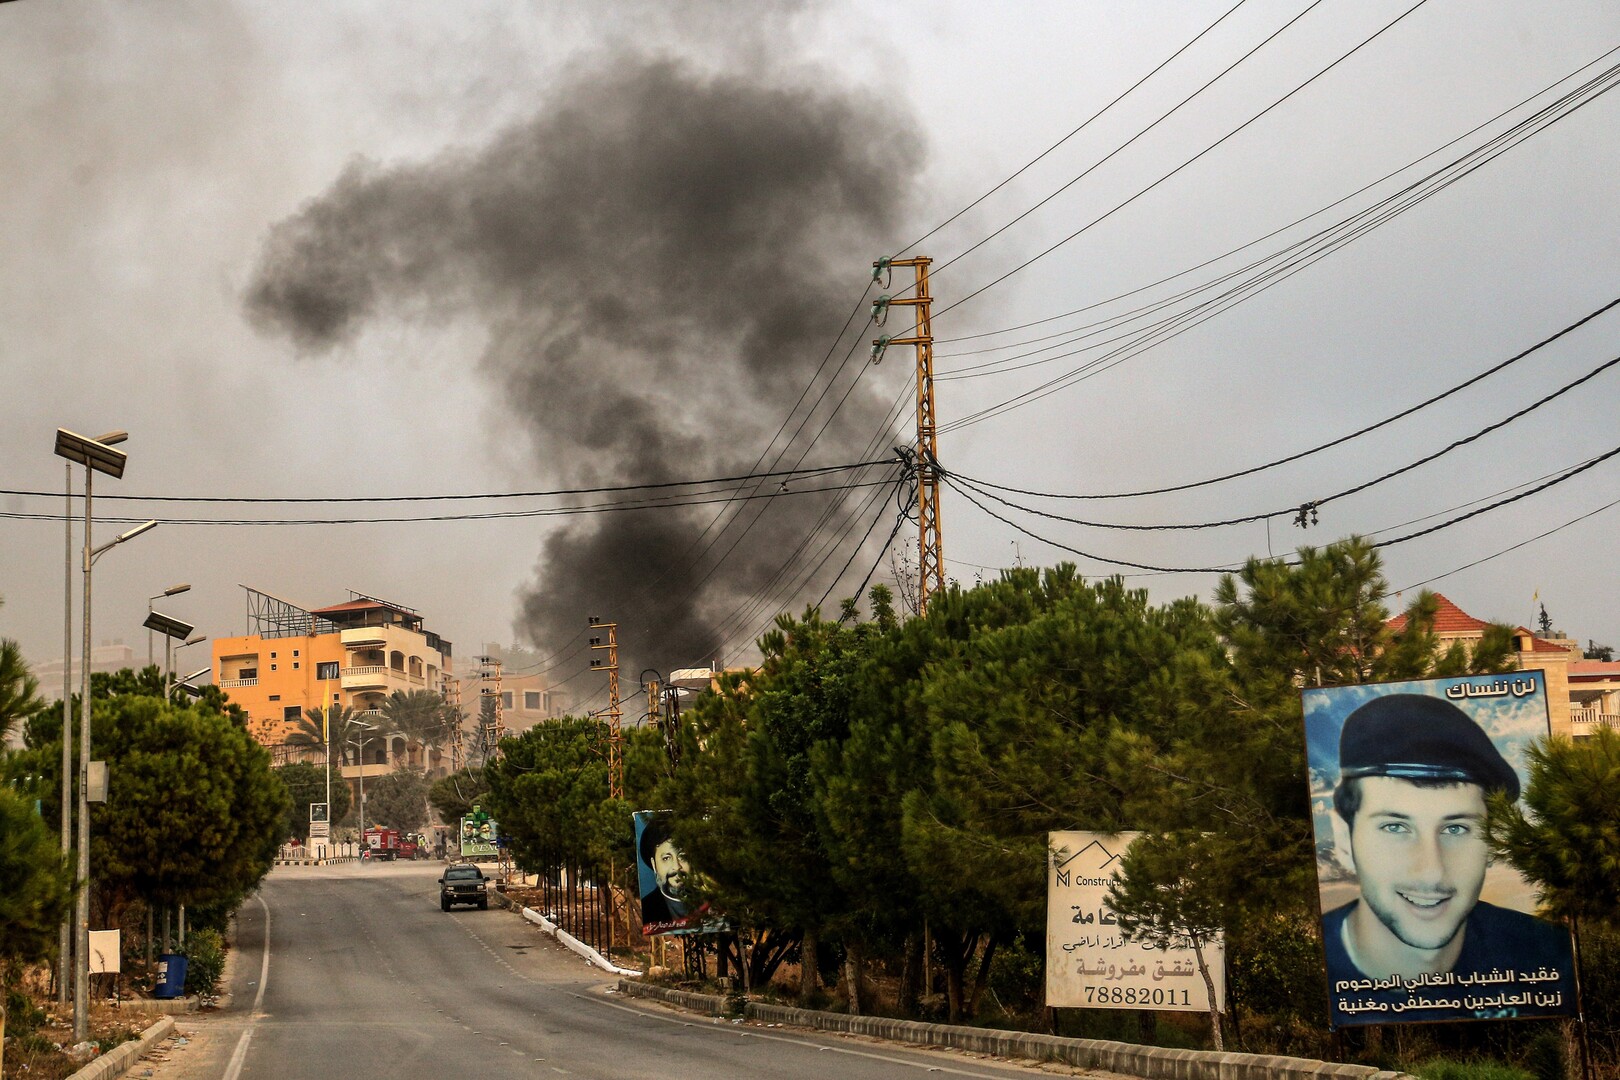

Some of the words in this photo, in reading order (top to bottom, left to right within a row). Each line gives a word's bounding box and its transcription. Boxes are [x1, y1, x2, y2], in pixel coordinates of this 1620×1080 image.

[1446, 680, 1509, 698] ننساك
[1511, 678, 1535, 697] لن
[1076, 957, 1146, 980] مفروشة
[1152, 958, 1195, 981] شقق
[1458, 967, 1515, 986] الشباب
[1518, 967, 1560, 985] فقيد
[1335, 974, 1401, 992] المرحوم
[1403, 972, 1455, 993] الغالي
[1084, 986, 1191, 1006] 78882011
[1391, 995, 1461, 1012] مصطفى
[1464, 991, 1531, 1010] العابدين
[1534, 991, 1562, 1006] زين
[1338, 998, 1389, 1014] مغنية
